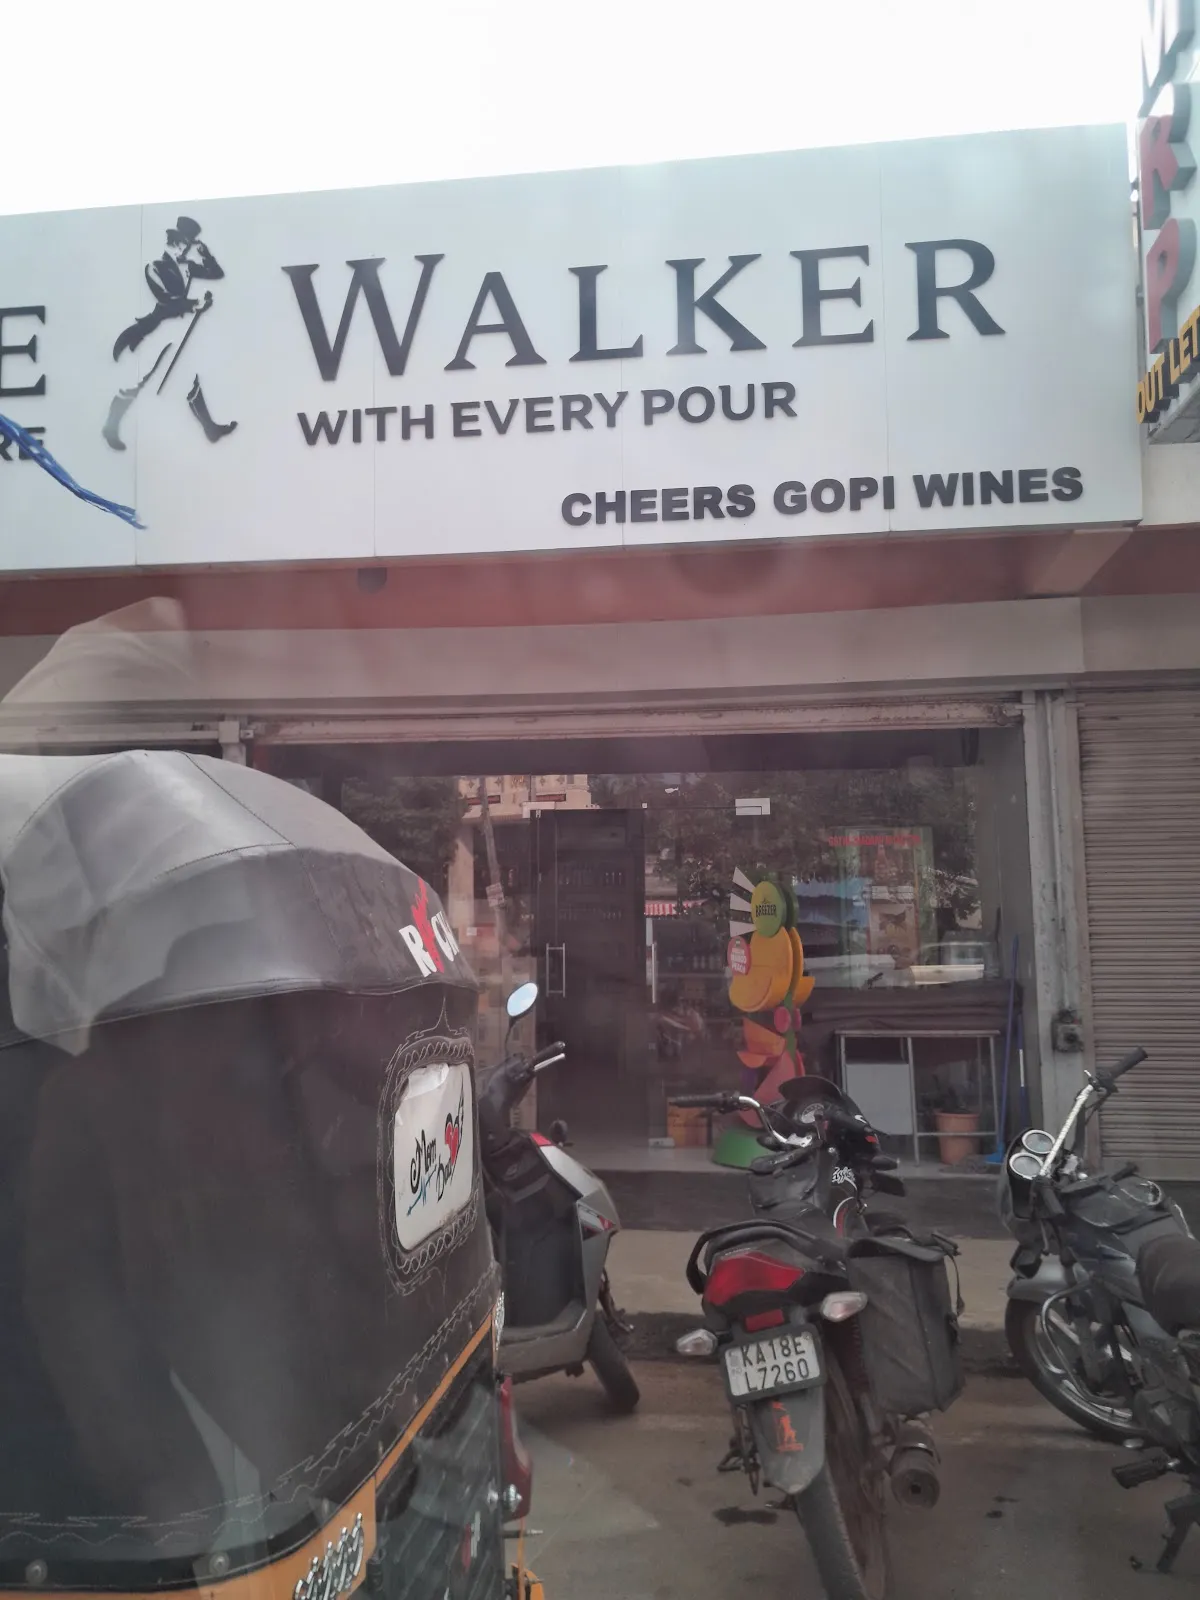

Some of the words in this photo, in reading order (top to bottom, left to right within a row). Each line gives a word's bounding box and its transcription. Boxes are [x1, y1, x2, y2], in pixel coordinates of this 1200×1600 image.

[281, 239, 1005, 382] WALKER
[297, 404, 435, 446] WITH
[450, 390, 629, 438] EVERY
[641, 381, 798, 426] POUR
[561, 483, 756, 527] CHEERS
[773, 475, 895, 515] GOPI
[913, 466, 1084, 508] WINES
[741, 1334, 806, 1368] KA18E
[744, 1358, 810, 1391] L7260
